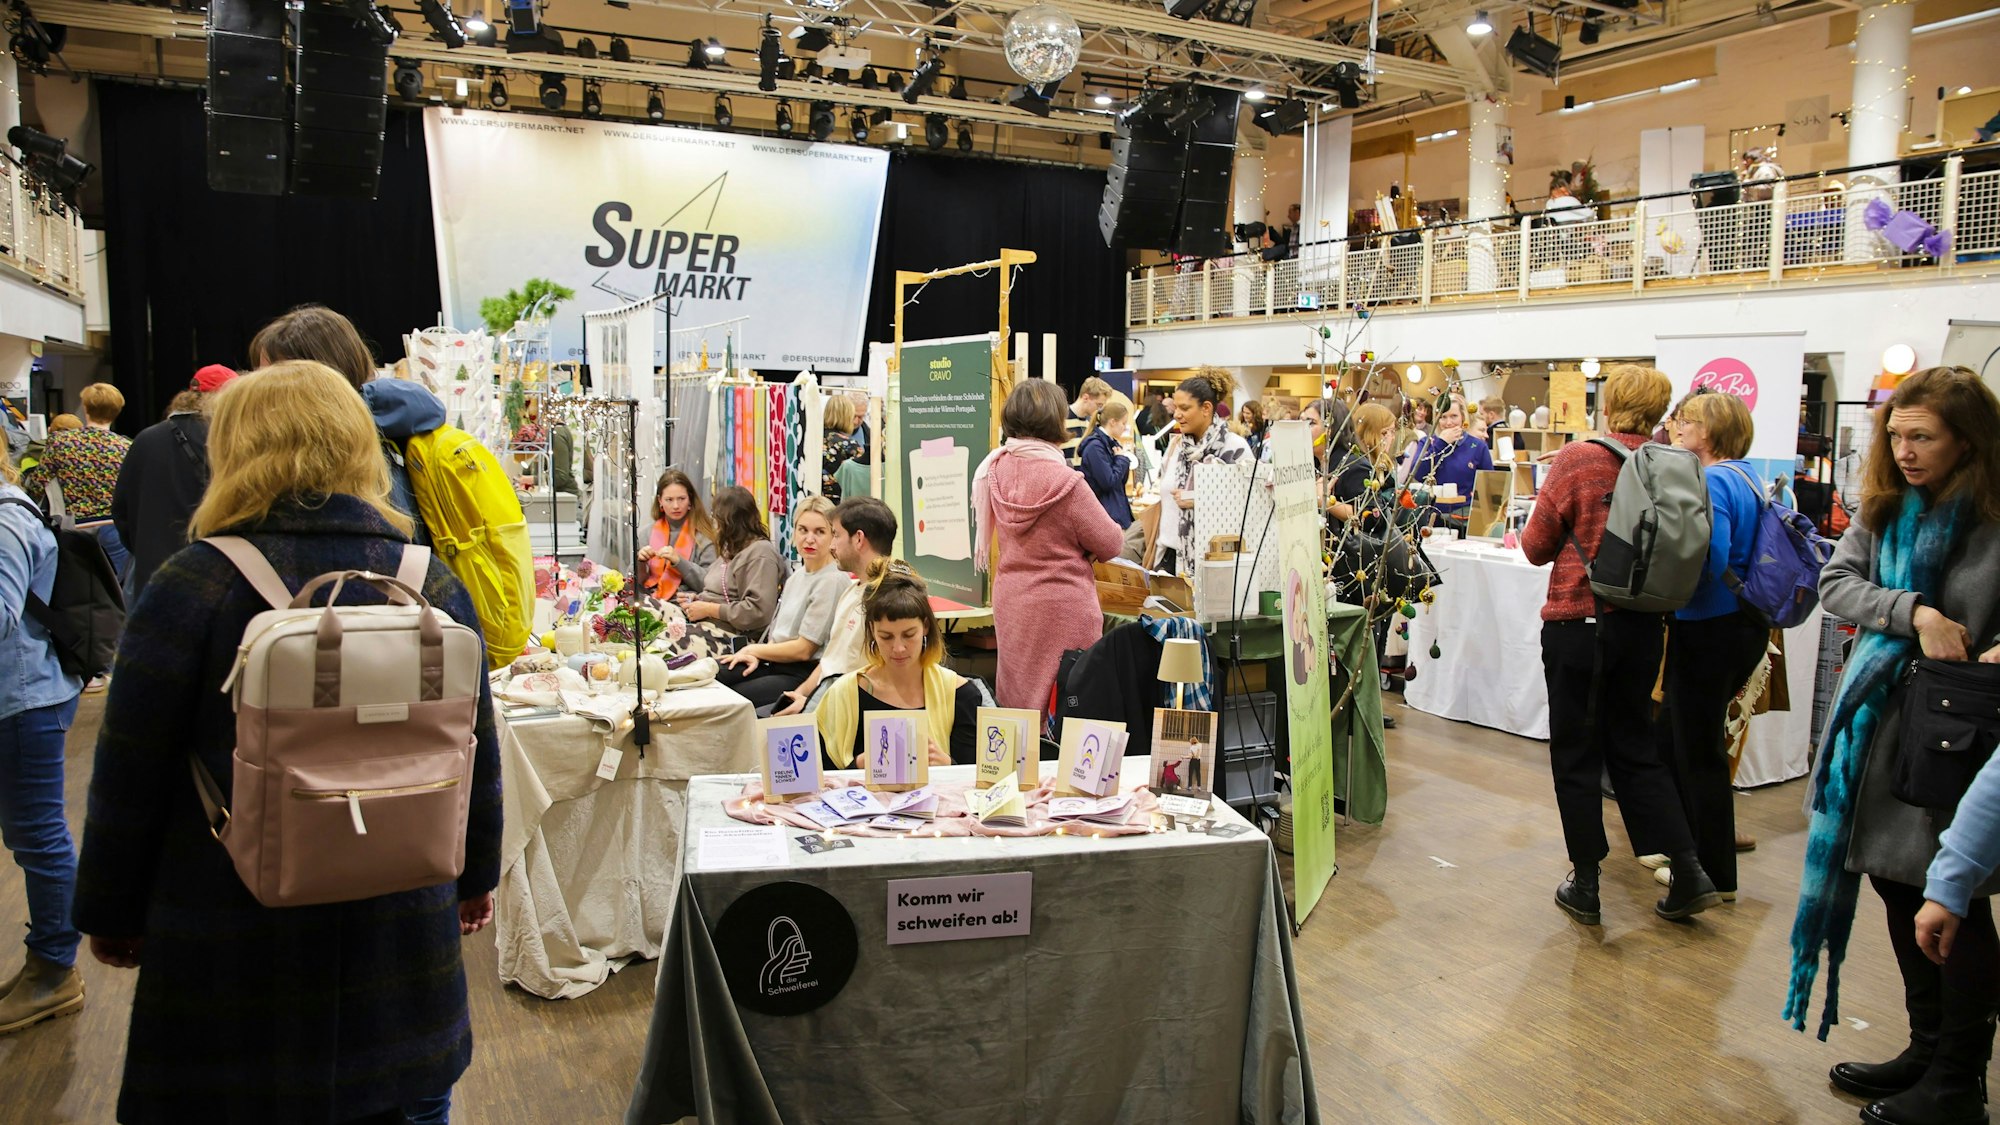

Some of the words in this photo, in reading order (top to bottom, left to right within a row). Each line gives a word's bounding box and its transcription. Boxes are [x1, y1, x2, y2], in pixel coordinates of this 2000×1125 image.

[440, 117, 586, 134] WWW.DERSUPERMARKT.NET
[603, 129, 736, 149] WWW.DERSUPERMARKT.NET
[752, 144, 873, 163] WWW.DERSUPERMARKT.NET
[584, 201, 740, 274] SUPER
[654, 272, 752, 301] MARKT
[929, 356, 952, 369] studio
[929, 370, 952, 382] CRAVO
[898, 893, 952, 907] Komm
[957, 888, 985, 903] wir
[897, 913, 987, 931] schweifen
[991, 910, 1018, 925] ab!
[767, 979, 819, 996] Schweiferei
